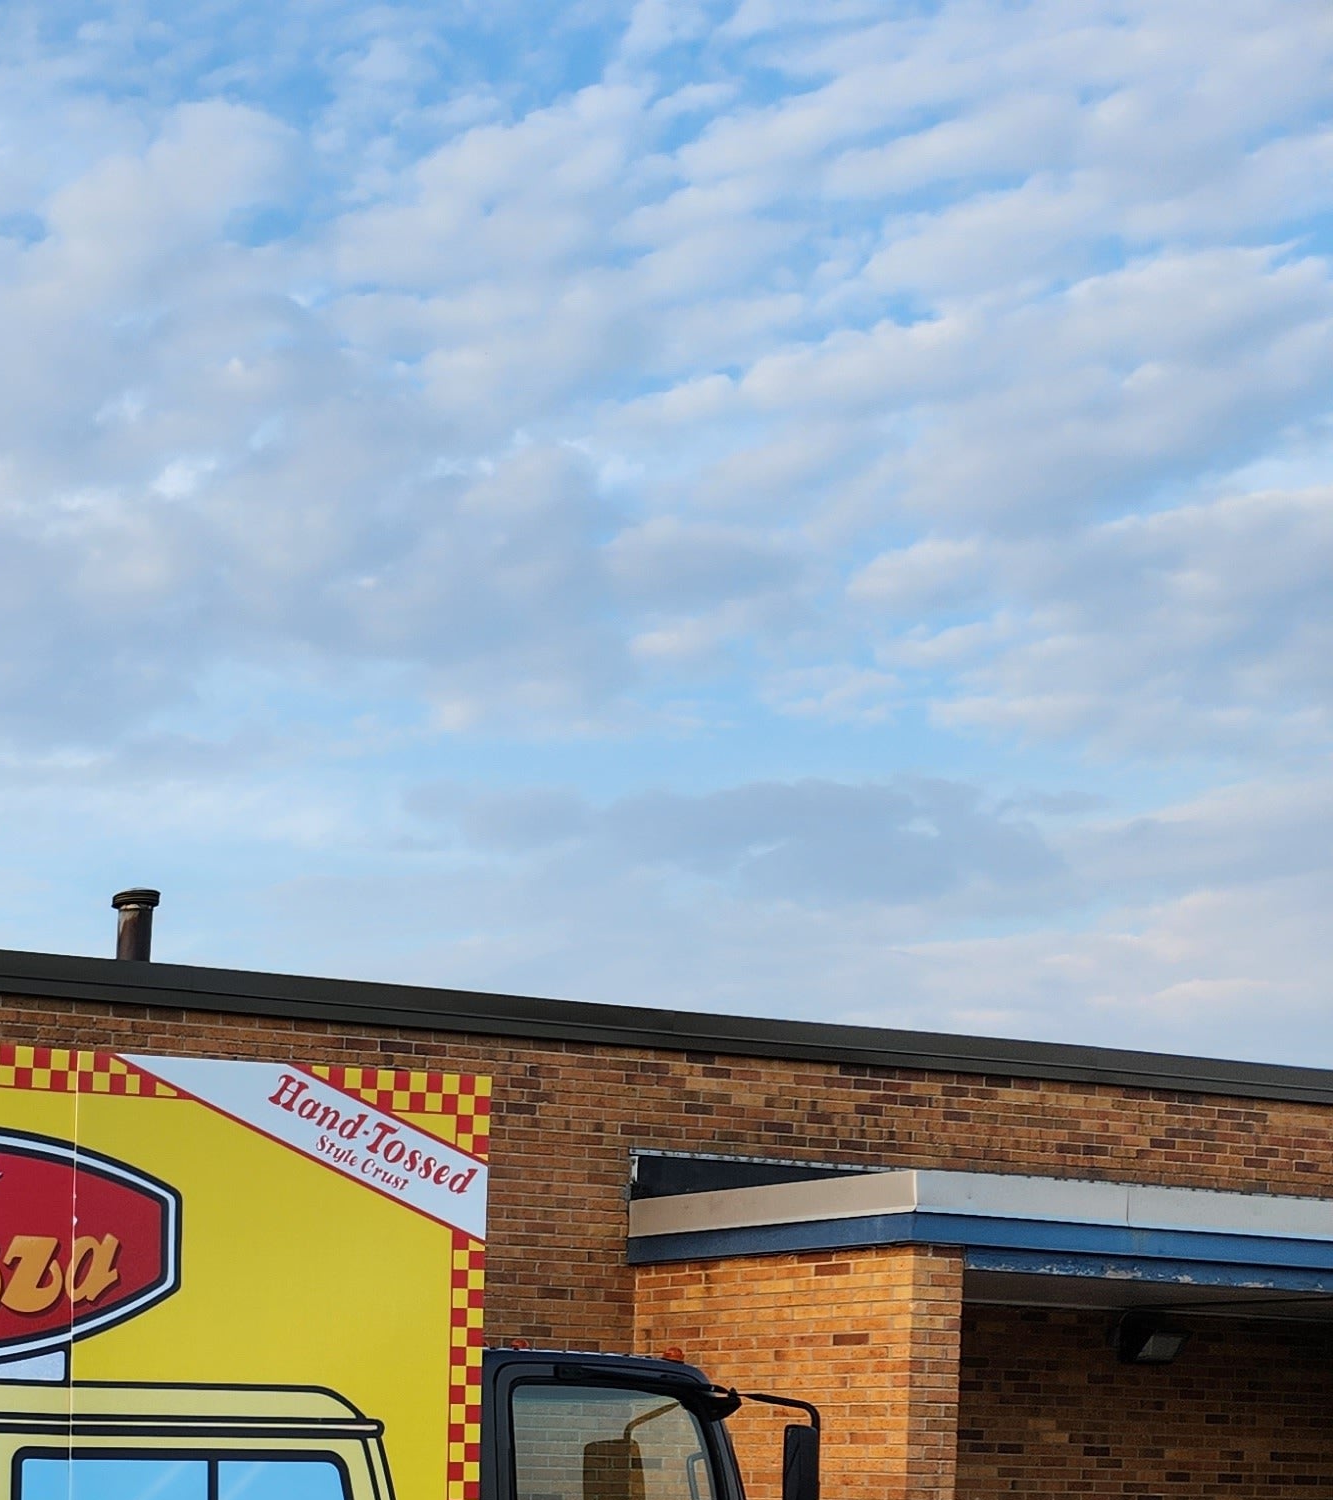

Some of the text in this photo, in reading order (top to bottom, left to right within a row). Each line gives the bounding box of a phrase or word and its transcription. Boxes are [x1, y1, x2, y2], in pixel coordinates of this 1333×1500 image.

[268, 1074, 479, 1195] Hand-Tossed
[315, 1135, 410, 1192] Style Crust
